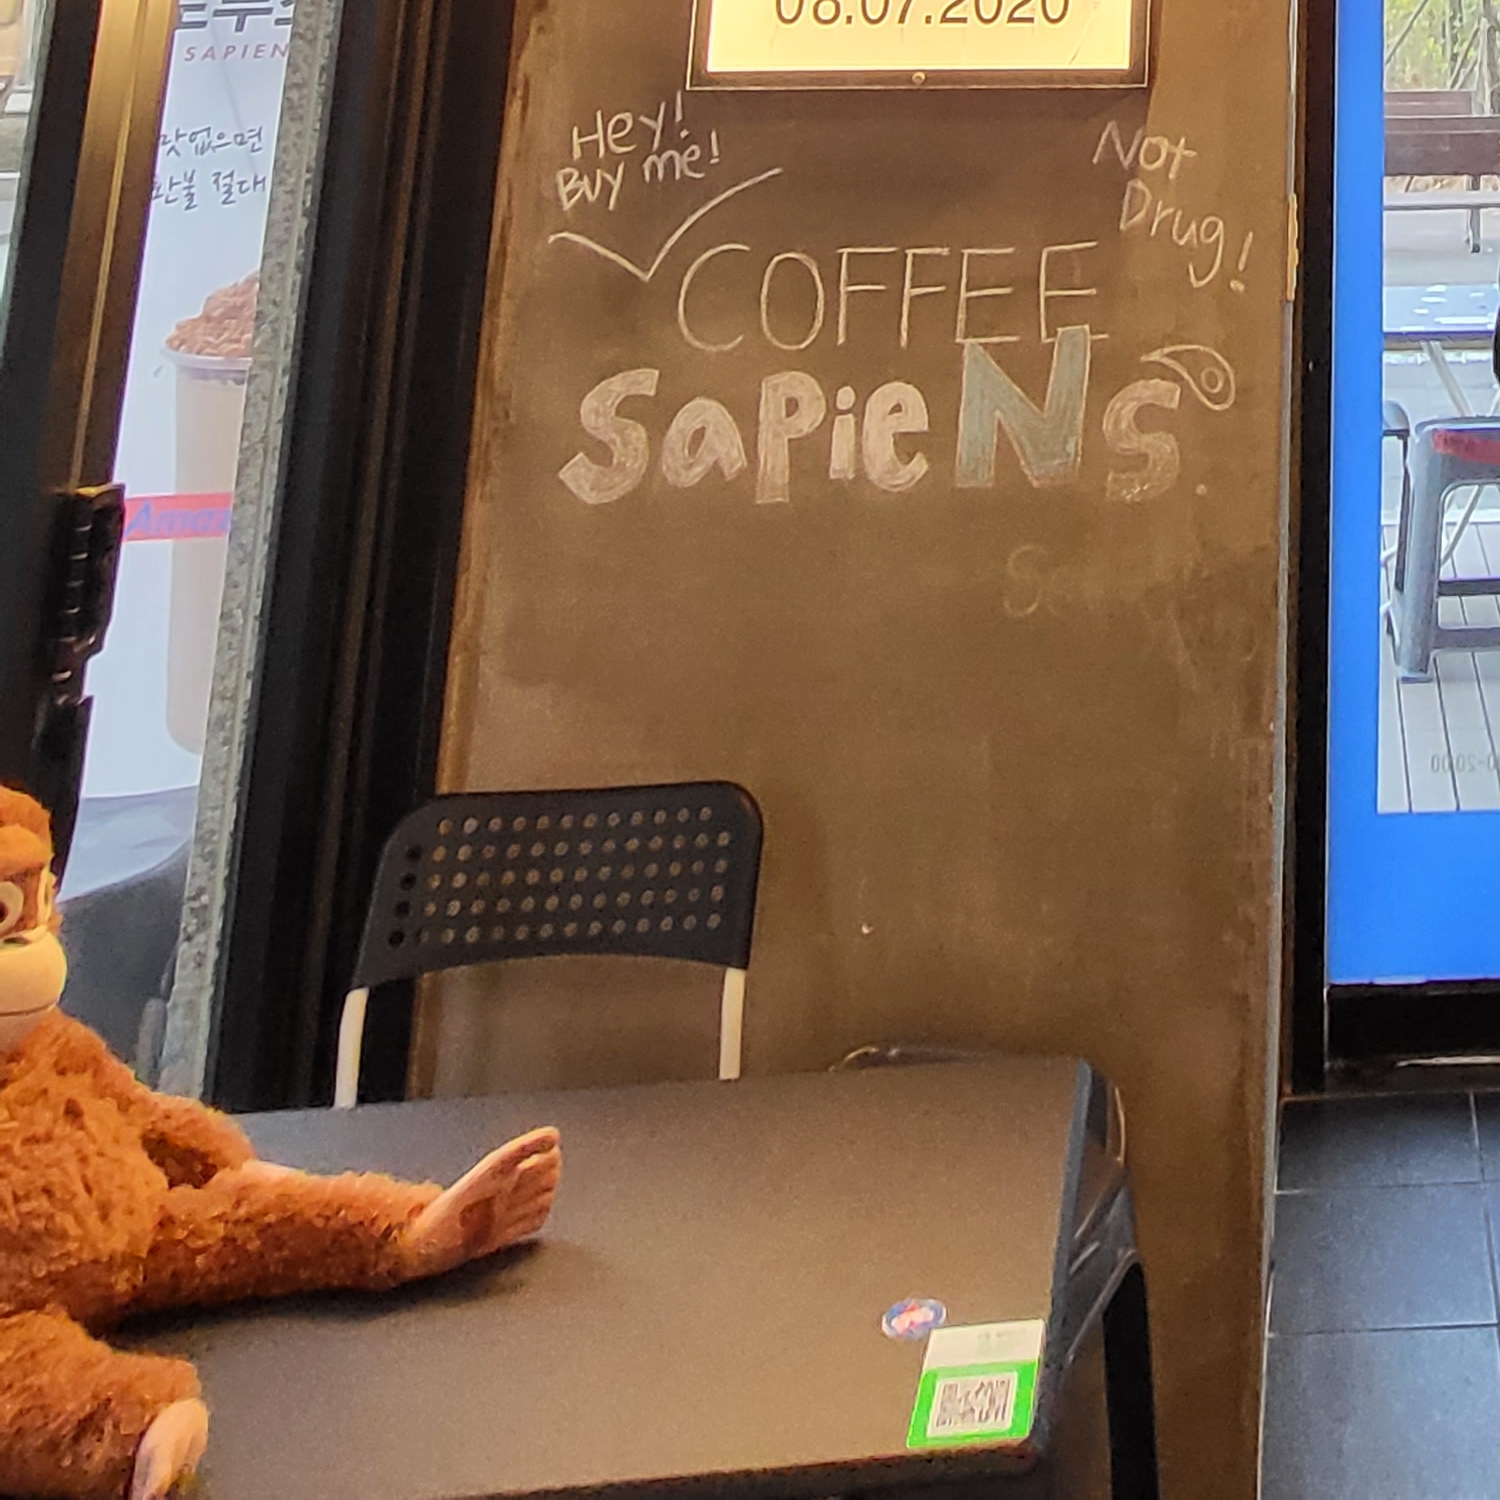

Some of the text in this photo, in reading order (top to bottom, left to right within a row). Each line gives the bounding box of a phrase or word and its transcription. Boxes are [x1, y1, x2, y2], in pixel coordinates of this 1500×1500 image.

[571, 91, 691, 161] Hey!
[1093, 119, 1197, 180] Not
[212, 170, 267, 206] 절대
[556, 131, 720, 213] Buy me!
[1119, 179, 1256, 292] Drug!
[678, 241, 1109, 352] COFFEE
